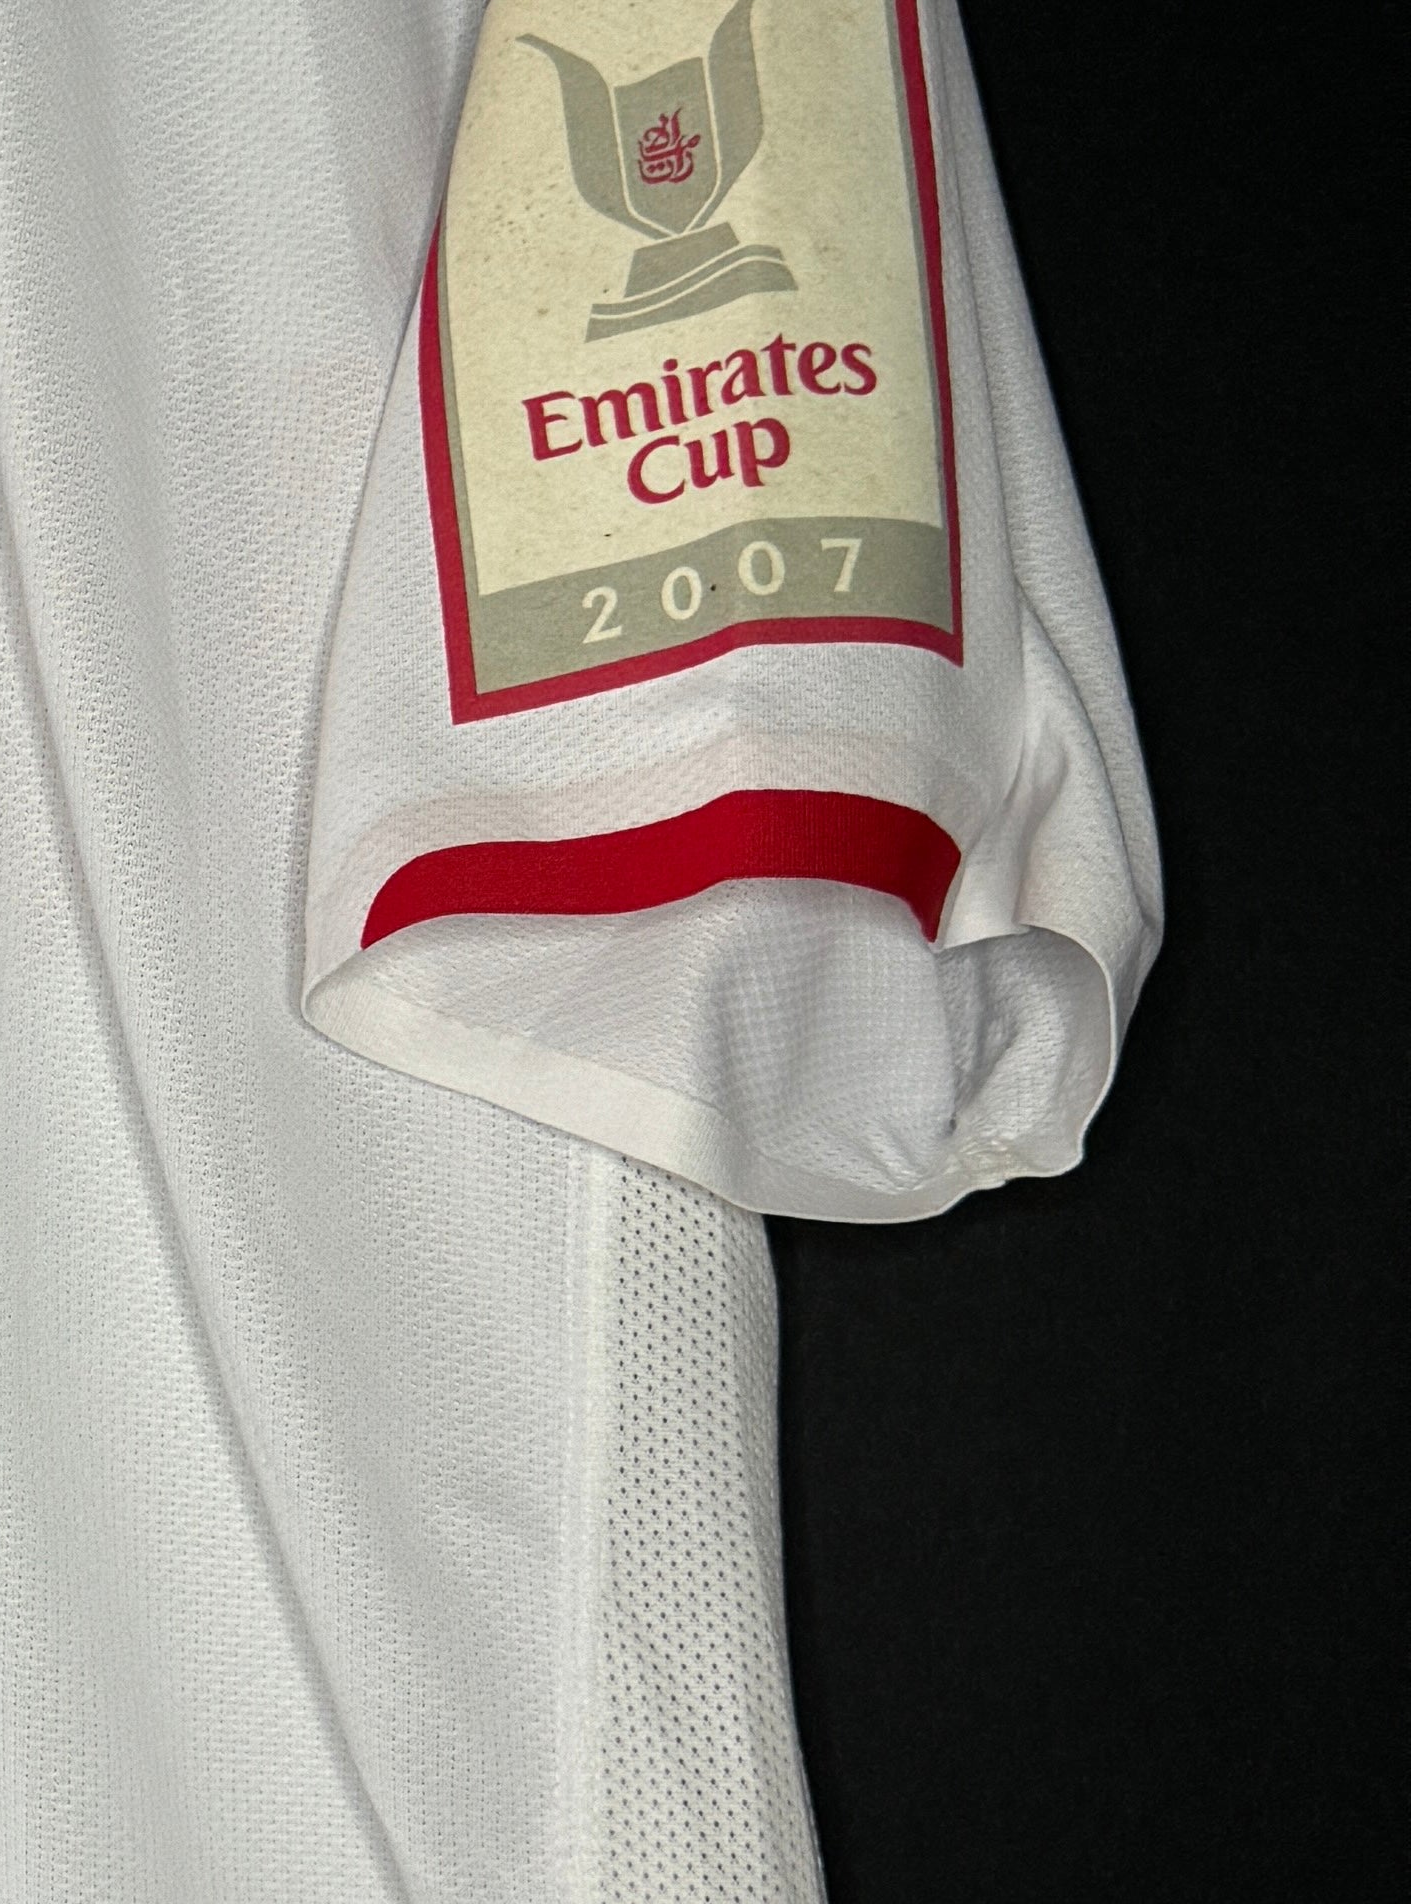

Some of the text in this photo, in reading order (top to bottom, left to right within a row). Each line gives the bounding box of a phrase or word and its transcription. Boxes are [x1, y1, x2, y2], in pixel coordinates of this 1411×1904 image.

[522, 333, 878, 461] Emirates
[626, 418, 792, 504] Cup
[581, 538, 864, 645] 2007
